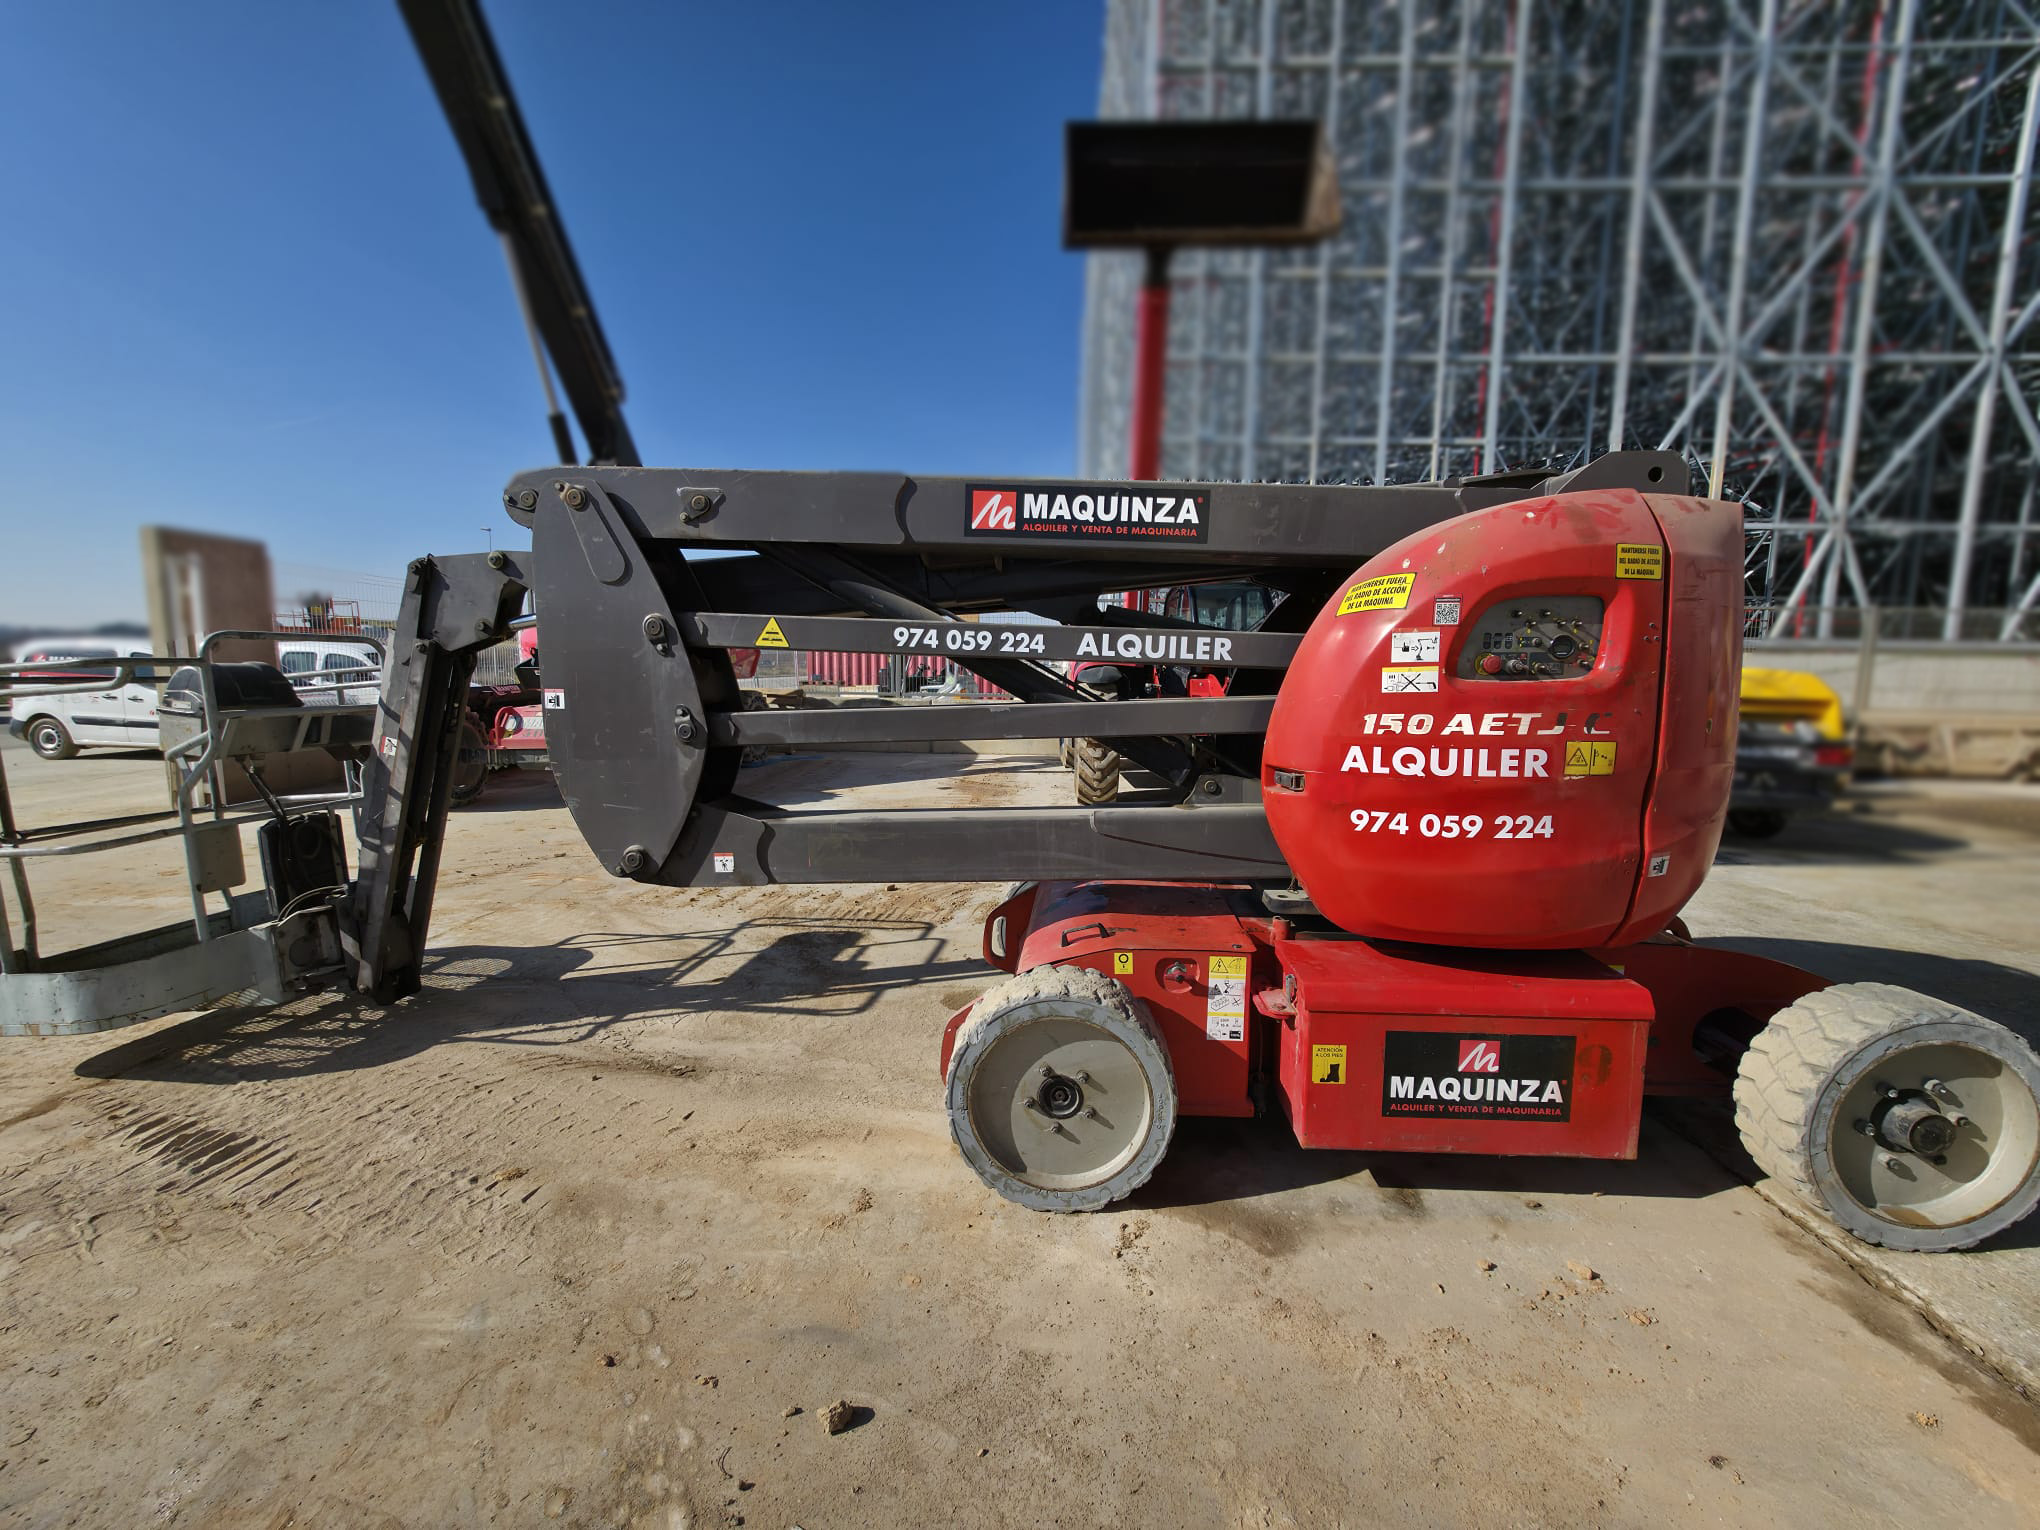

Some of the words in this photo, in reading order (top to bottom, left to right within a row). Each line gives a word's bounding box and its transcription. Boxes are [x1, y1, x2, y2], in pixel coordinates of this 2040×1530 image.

[1023, 493, 1200, 524] MAQUINZA
[1022, 523, 1068, 533] ALQUILER
[1071, 524, 1077, 533] Y
[1081, 525, 1113, 534] VENTA
[1116, 526, 1128, 535] DE
[1131, 527, 1197, 537] MAQUINARIA
[1386, 576, 1407, 585] FUERA
[1354, 590, 1372, 600] RADIO
[1372, 588, 1382, 597] DE
[1347, 602, 1355, 610] DE
[1355, 601, 1362, 609] LA
[893, 626, 939, 649] 974
[946, 629, 993, 651] 059
[1000, 632, 1046, 654] 224
[1076, 632, 1233, 662] ALQUILER
[1363, 713, 1434, 735] 150
[1340, 745, 1550, 778] ALQUILER
[1349, 809, 1409, 835] 974
[1419, 812, 1484, 839] 059
[1493, 814, 1554, 839] 224
[1389, 1075, 1564, 1104] MAQUINZA
[1389, 1103, 1435, 1112] ALQUILER
[1438, 1104, 1445, 1112] Y
[1447, 1105, 1479, 1113] VENTA
[1481, 1106, 1494, 1114] DE
[1497, 1106, 1562, 1117] MAQUINARIA
